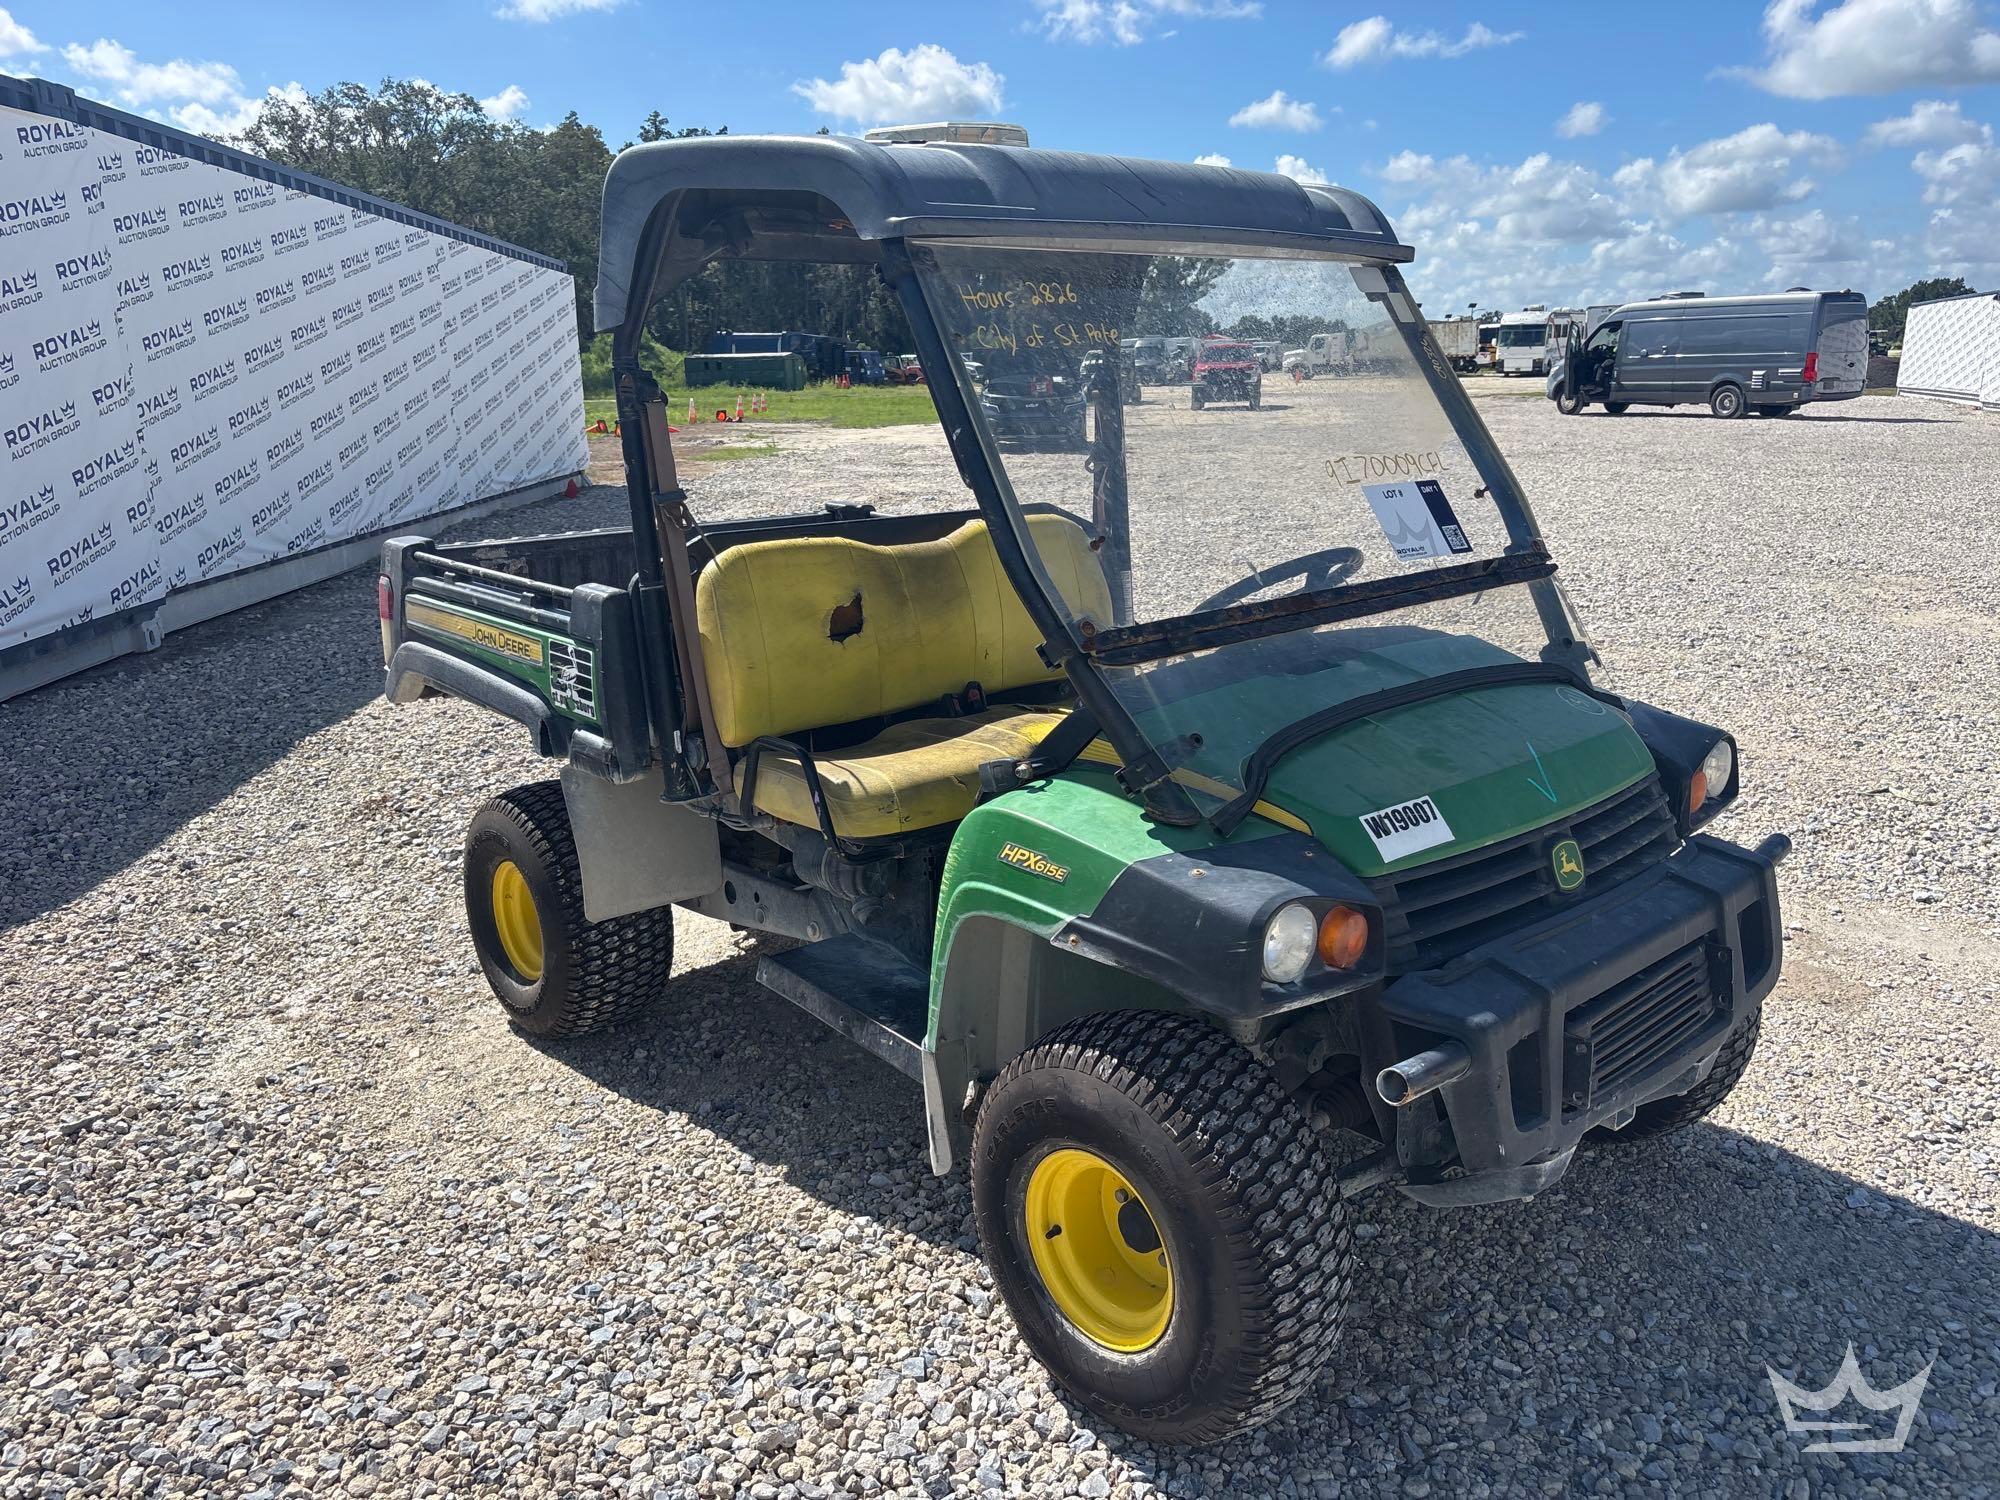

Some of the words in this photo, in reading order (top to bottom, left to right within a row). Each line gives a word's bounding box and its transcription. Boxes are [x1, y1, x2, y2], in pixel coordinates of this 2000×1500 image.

[17, 122, 74, 144] ROYAL
[24, 144, 62, 158] AUCTION
[64, 139, 88, 152] GROUP
[102, 172, 126, 184] GROUP
[141, 165, 168, 176] AUCTION
[168, 162, 189, 171] GROUP
[178, 196, 214, 217] ROYAL
[234, 185, 264, 203] ROYAL
[40, 212, 70, 227] GROUP
[113, 210, 155, 233] ROYAL
[183, 215, 207, 228] AUCTION
[208, 210, 226, 221] GROUP
[314, 215, 338, 232] ROYAL
[118, 230, 147, 245] AUCTION
[147, 224, 169, 237] GROUP
[271, 227, 298, 246] ROYAL
[56, 251, 105, 279] ROYAL
[221, 241, 252, 263] ROYAL
[62, 274, 97, 292] AUCTION
[162, 258, 200, 282] ROYAL
[167, 277, 193, 292] AUCTION
[193, 270, 212, 283] GROUP
[302, 266, 326, 286] ROYAL
[11, 291, 43, 309] GROUP
[130, 290, 153, 305] GROUP
[256, 283, 284, 305] ROYAL
[1026, 282, 1076, 305] 2826
[204, 302, 237, 326] ROYAL
[332, 302, 354, 322] ROYAL
[33, 327, 90, 360] ROYAL
[142, 324, 181, 352] ROYAL
[292, 320, 317, 342] ROYAL
[977, 322, 1016, 356] City
[1027, 324, 1043, 346] of
[1084, 323, 1120, 346] Pete
[39, 351, 78, 373] AUCTION
[79, 339, 107, 357] GROUP
[147, 344, 174, 362] AUCTION
[175, 335, 195, 350] GROUP
[244, 340, 274, 365] ROYAL
[190, 364, 224, 392] ROYAL
[321, 354, 344, 377] ROYAL
[194, 384, 218, 402] AUCTION
[219, 374, 237, 389] GROUP
[277, 376, 304, 402] ROYAL
[160, 403, 181, 419] GROUP
[229, 402, 260, 430] ROYAL
[311, 408, 335, 433] ROYAL
[4, 410, 63, 448] ROYAL
[12, 435, 50, 462] AUCTION
[51, 420, 80, 440] GROUP
[171, 431, 207, 463] ROYAL
[176, 452, 201, 474] AUCTION
[201, 440, 220, 457] GROUP
[266, 434, 294, 462] ROYAL
[339, 438, 361, 463] ROYAL
[72, 449, 124, 487] ROYAL
[80, 473, 113, 498] AUCTION
[114, 458, 139, 479] GROUP
[215, 464, 248, 496] ROYAL
[297, 465, 323, 493] ROYAL
[329, 491, 352, 519] ROYAL
[1382, 490, 1397, 498] LOT
[0, 495, 41, 531] OYAL
[30, 504, 60, 528] GROUP
[252, 496, 282, 528] ROYAL
[160, 522, 186, 547] AUCTION
[187, 507, 206, 527] GROUP
[288, 523, 314, 554] ROYAL
[47, 533, 101, 576] ROYAL
[198, 532, 232, 568] ROYAL
[202, 554, 226, 578] AUCTION
[226, 539, 244, 558] GROUP
[54, 558, 90, 589] AUCTION
[89, 540, 116, 562] GROUP
[110, 563, 157, 605] ROYAL
[6, 595, 35, 622] GROUP
[472, 624, 496, 647] JOHN
[499, 632, 532, 658] DEERE
[1364, 799, 1438, 839] W19007
[1000, 844, 1067, 880] HPX615E
